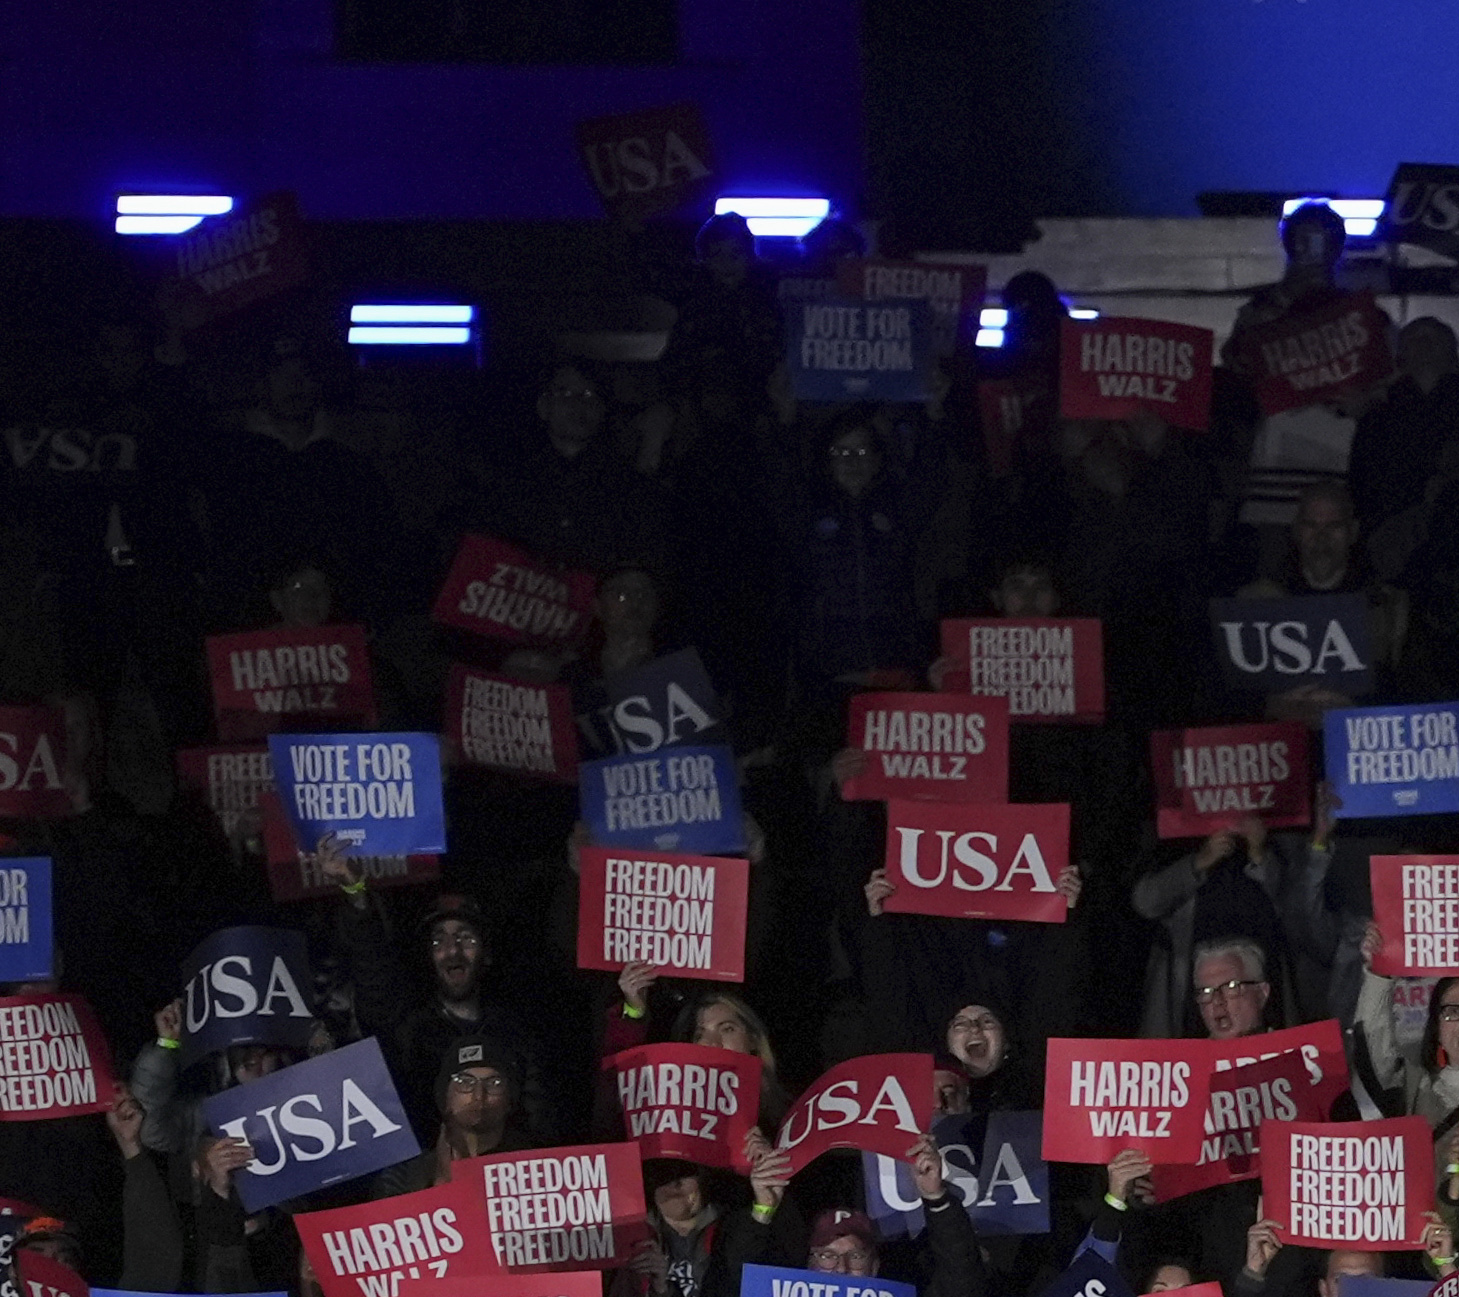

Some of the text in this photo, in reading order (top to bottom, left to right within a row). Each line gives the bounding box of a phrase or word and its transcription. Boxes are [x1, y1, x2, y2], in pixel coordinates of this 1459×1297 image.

[1082, 335, 1193, 379] HARRIS
[1098, 375, 1176, 402] WALZ
[291, 744, 411, 781] VOTE FOR
[295, 782, 414, 819] FREEDOM
[897, 827, 1057, 892] USA
[1071, 1061, 1189, 1107] HARRIS
[1090, 1111, 1171, 1137] WALZ
